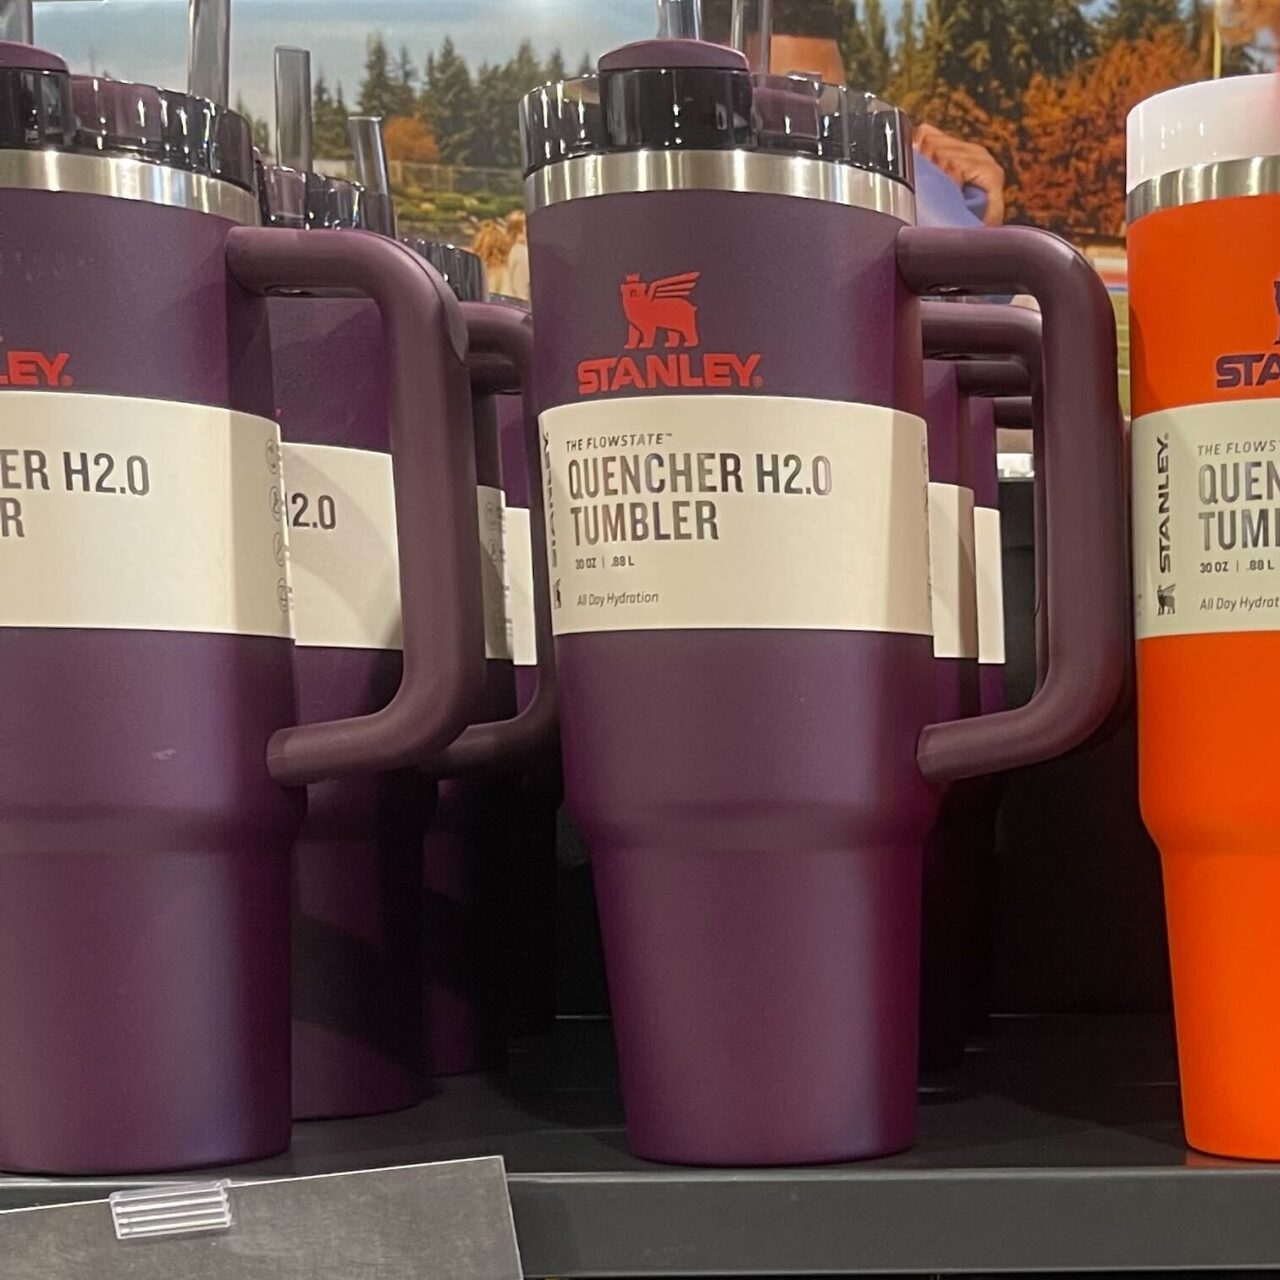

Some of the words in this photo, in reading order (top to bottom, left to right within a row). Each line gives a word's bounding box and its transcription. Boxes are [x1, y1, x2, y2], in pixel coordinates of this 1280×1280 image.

[566, 439, 582, 452] THE
[1197, 443, 1221, 457] THE
[63, 451, 150, 497] H2.0
[568, 453, 744, 500] QUENCHER
[756, 453, 832, 497] H2.0
[286, 492, 337, 530] 2.0
[570, 500, 719, 546] TUMBLER
[585, 557, 596, 569] OZ
[628, 555, 635, 566] L
[1214, 561, 1229, 573] OZ
[1267, 559, 1275, 570] L
[577, 593, 587, 607] All
[589, 593, 605, 608] Day
[607, 591, 659, 607] Hydration
[1199, 598, 1214, 611] All
[1216, 597, 1237, 613] Day
